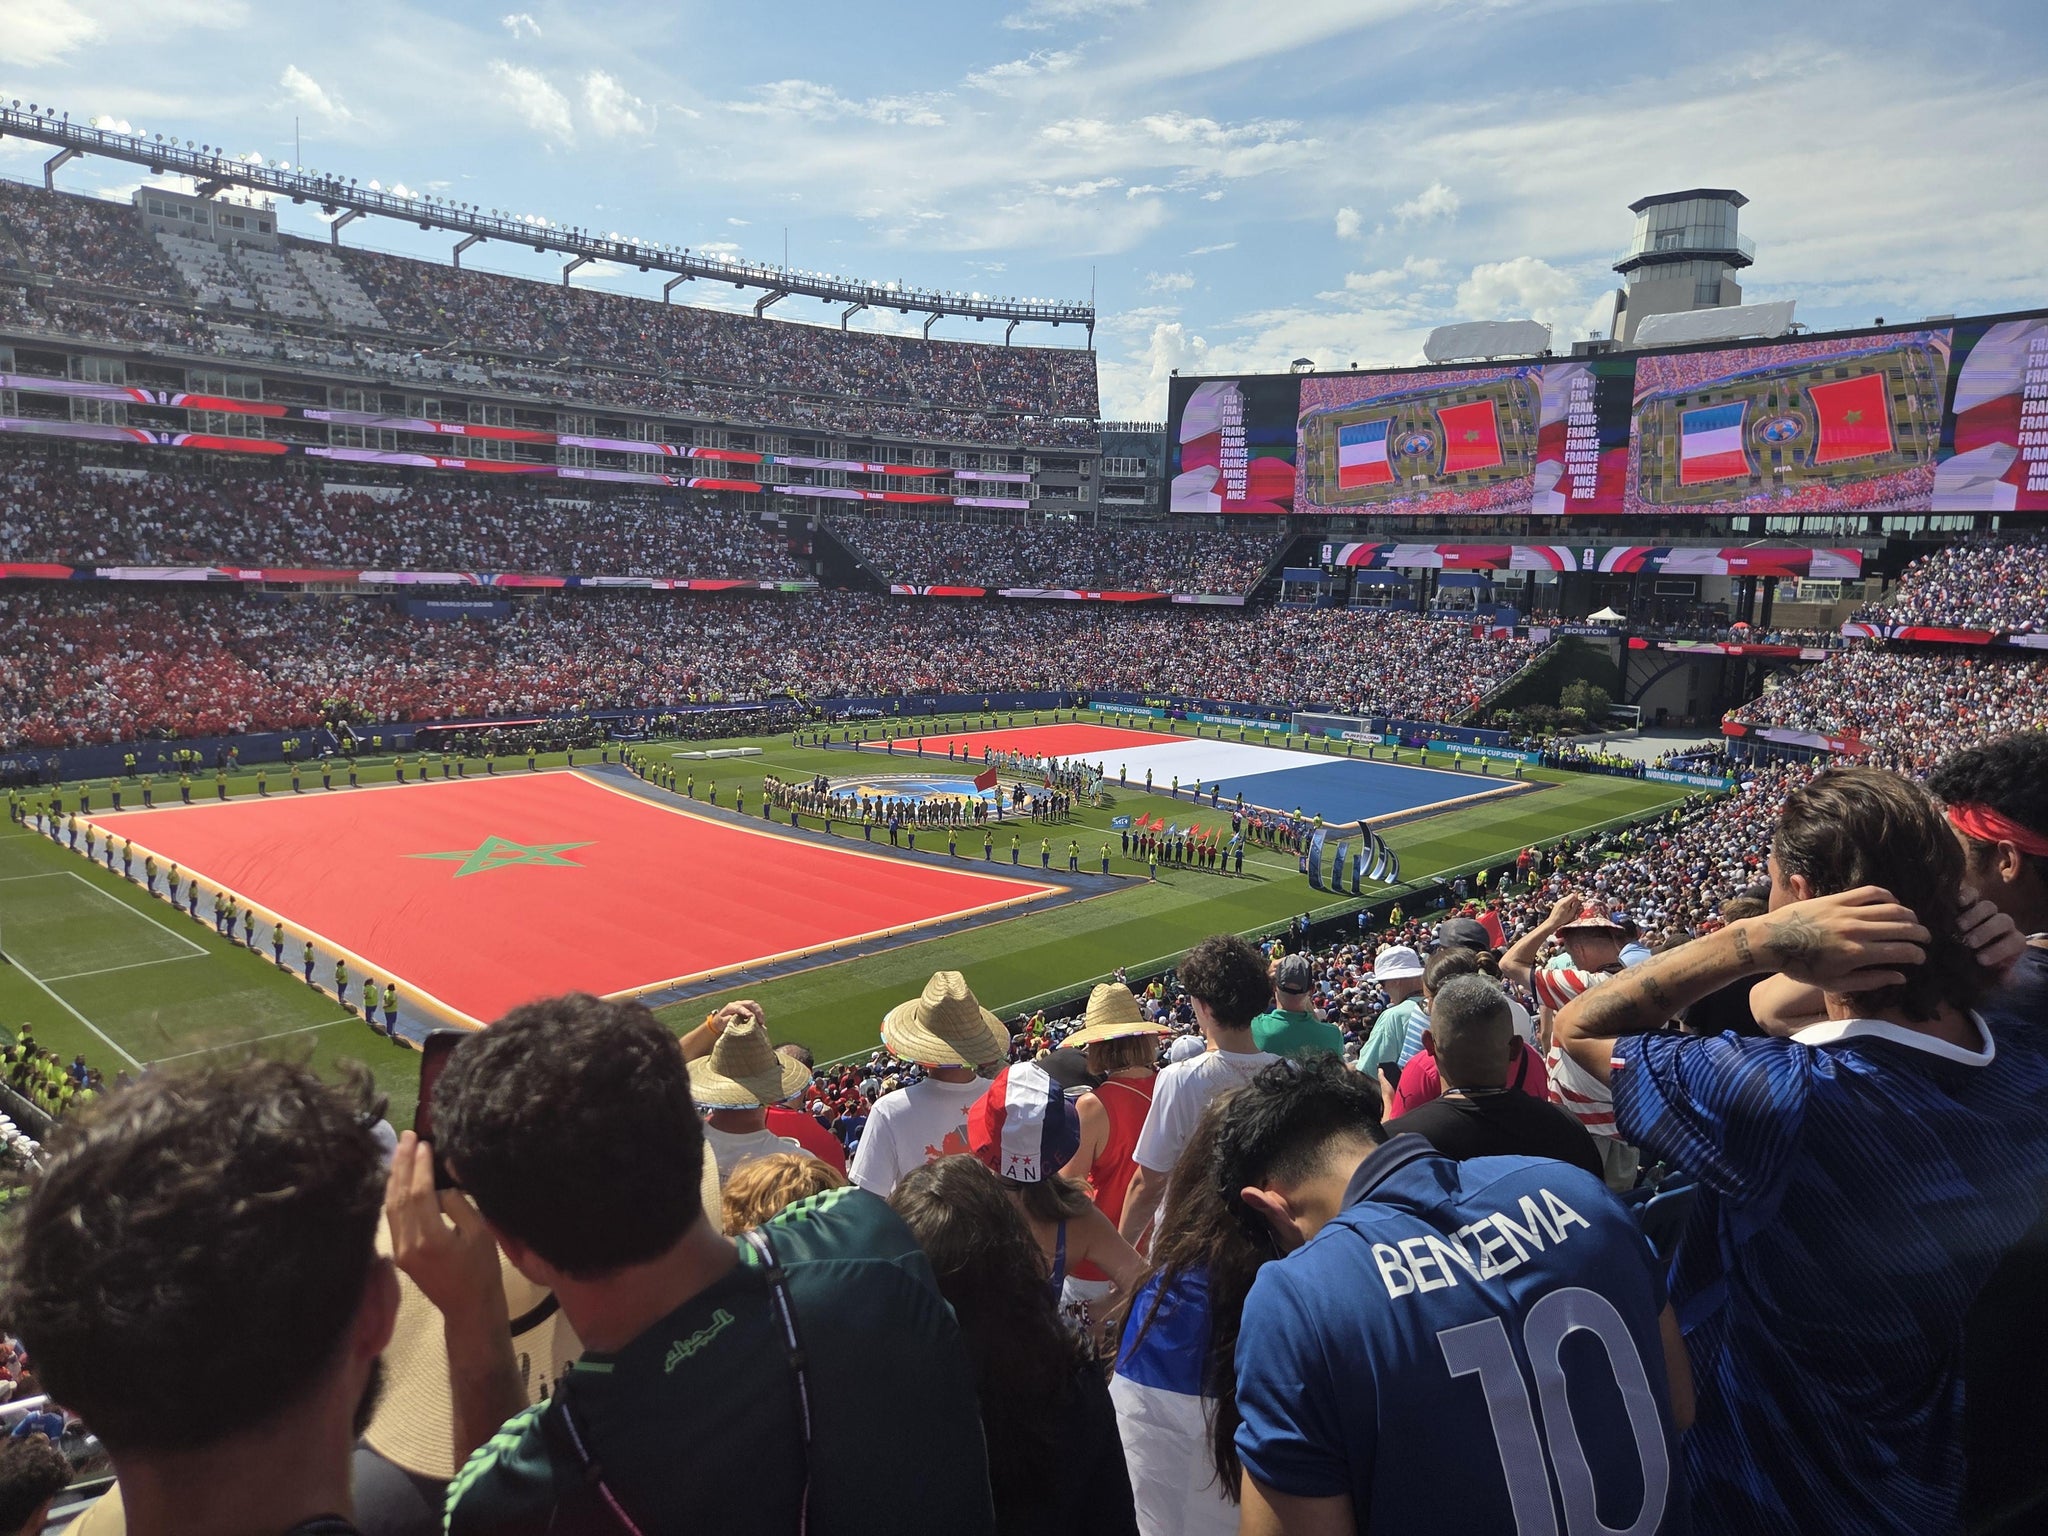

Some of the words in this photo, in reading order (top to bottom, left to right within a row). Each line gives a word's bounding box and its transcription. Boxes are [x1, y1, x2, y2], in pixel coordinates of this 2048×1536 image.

[2021, 399, 2048, 414] FRA
[440, 423, 465, 434] FRANCE
[1565, 438, 1600, 450] FRANCE
[1220, 447, 1249, 458] FRANCE
[1564, 451, 1599, 462] FRANCE
[440, 458, 466, 468] FRANCE
[773, 455, 792, 464] FRANCE
[1219, 458, 1248, 468] FRANCE
[866, 464, 885, 473] FRANCE
[1222, 469, 1247, 479] RANCE
[1568, 463, 1598, 475] RANCE
[1774, 465, 1792, 474] FIFA
[2028, 461, 2048, 476] AN
[1226, 479, 1247, 490] ANCE
[1572, 475, 1596, 487] ANCE
[866, 492, 884, 500] FRANCE
[1226, 490, 1246, 500] ANCE
[1571, 487, 1595, 499] ANCE
[1563, 627, 1608, 635] BOSTON
[1462, 745, 1486, 755] WORLD
[1487, 749, 1501, 757] CUP
[1501, 751, 1527, 760] 2026
[1645, 770, 1669, 780] WORLD
[1687, 775, 1706, 785] YOUR
[1706, 778, 1723, 788] WAY
[1371, 1188, 1591, 1300] BENZEMA
[1435, 1286, 1670, 1536] 10
